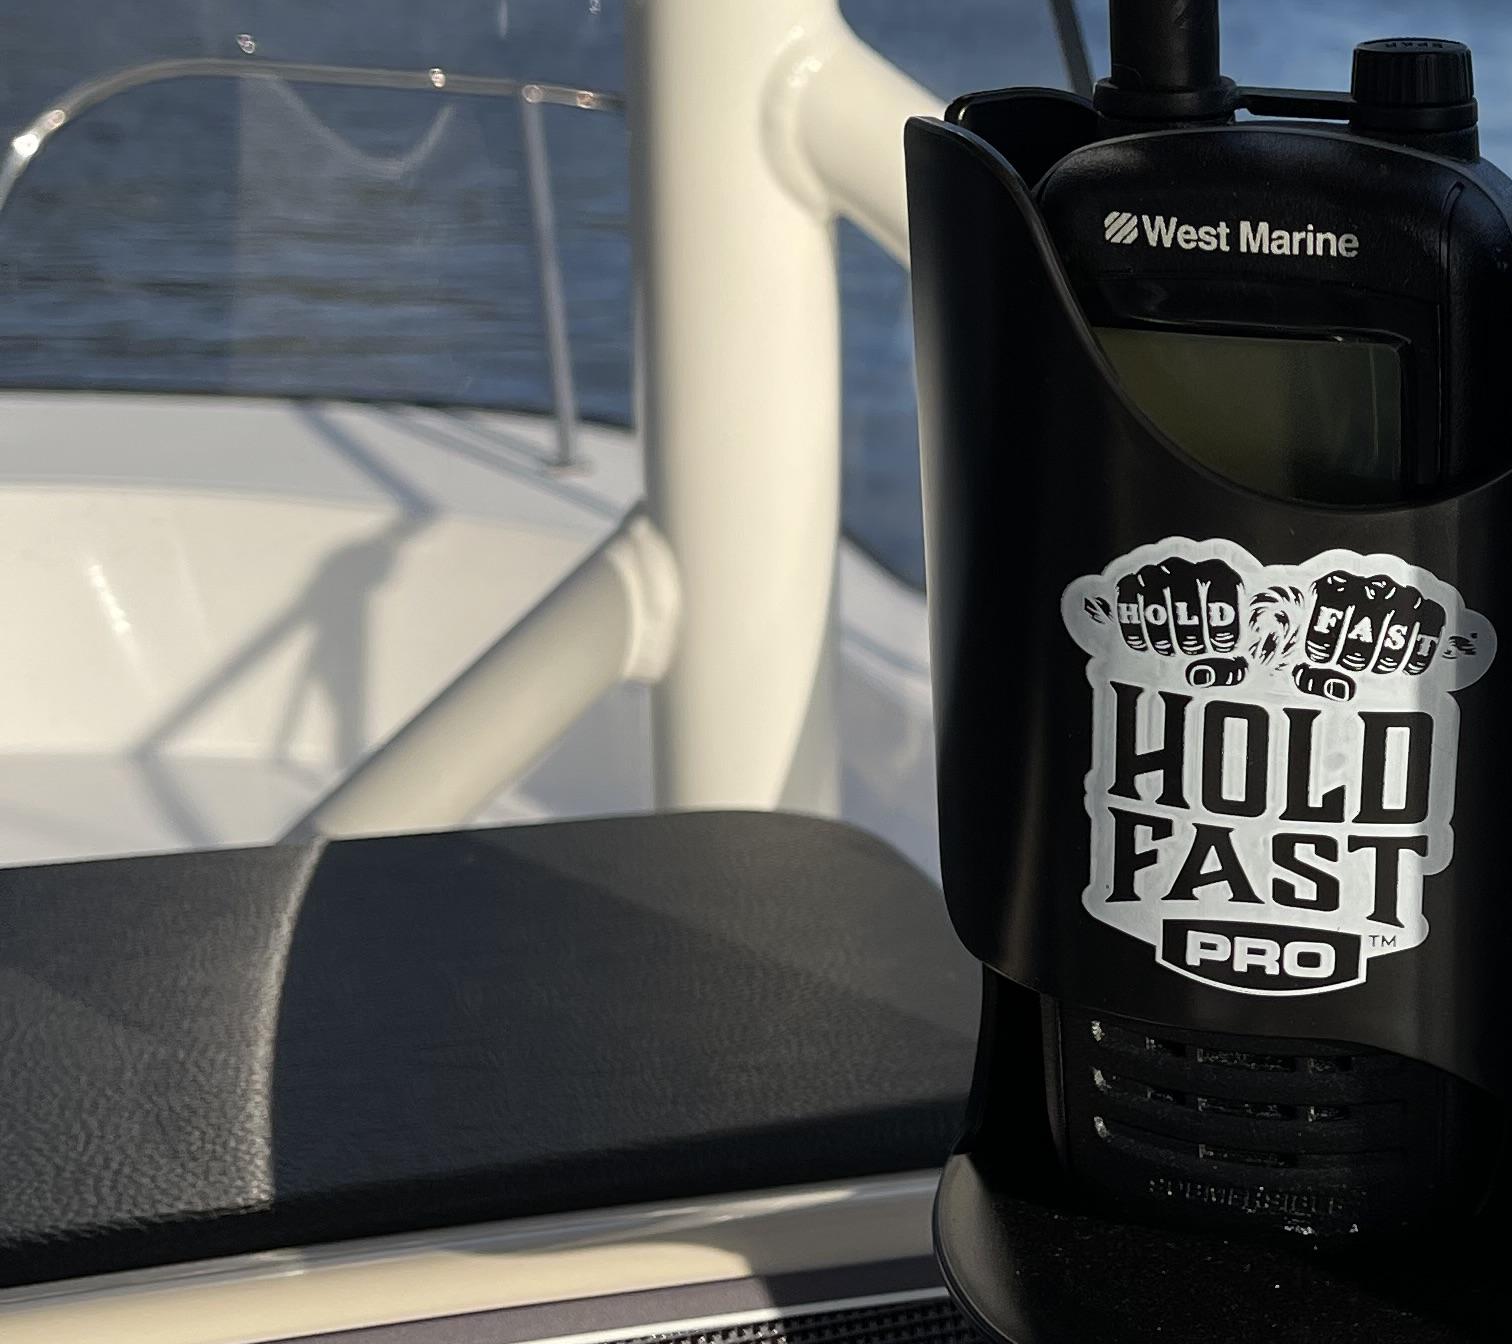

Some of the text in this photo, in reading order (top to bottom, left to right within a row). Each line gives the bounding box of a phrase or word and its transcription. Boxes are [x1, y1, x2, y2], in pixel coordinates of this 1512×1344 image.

[1142, 214, 1360, 258] West Marine
[1118, 600, 1439, 658] HOLD FAST
[1107, 680, 1435, 825] HOLD
[1105, 805, 1429, 929] FAST
[1186, 929, 1336, 979] PRO
